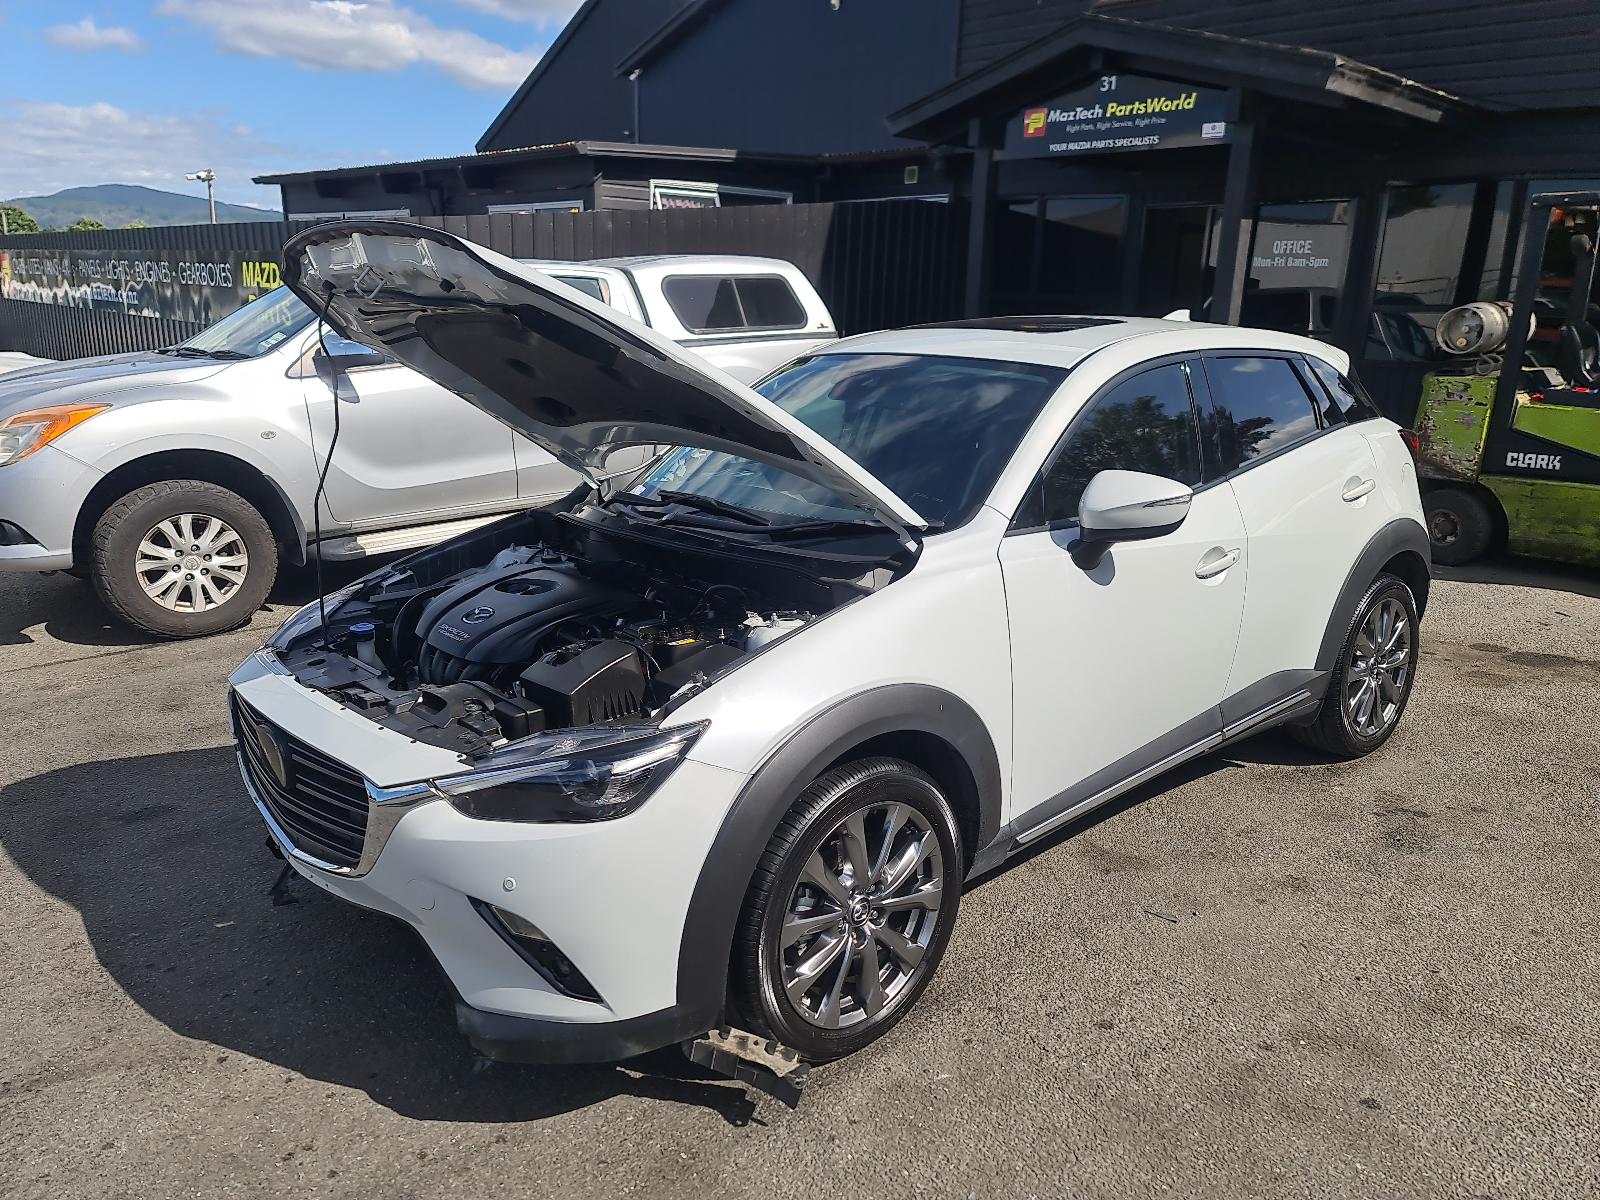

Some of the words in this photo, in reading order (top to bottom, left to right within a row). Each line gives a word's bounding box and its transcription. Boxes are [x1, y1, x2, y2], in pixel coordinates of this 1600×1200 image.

[1101, 75, 1117, 91] 31
[1047, 104, 1103, 122] MazTech
[1105, 92, 1197, 117] PartsWorld
[1096, 121, 1111, 131] Right
[1135, 118, 1150, 127] Right
[1049, 143, 1067, 152] YOUR
[1068, 141, 1091, 151] MAZDA
[1092, 138, 1114, 149] PARTS
[1114, 135, 1160, 147] SPECIALISTS
[1272, 240, 1312, 254] OFFICE
[1253, 256, 1285, 267] Mon-Fri
[1287, 256, 1328, 268] 8am-5pm
[105, 259, 130, 280] LIGHTS
[134, 260, 171, 282] ENGINES
[178, 261, 233, 287] GEARBOXES
[242, 261, 285, 288] MAZD
[1505, 451, 1562, 470] CLARK
